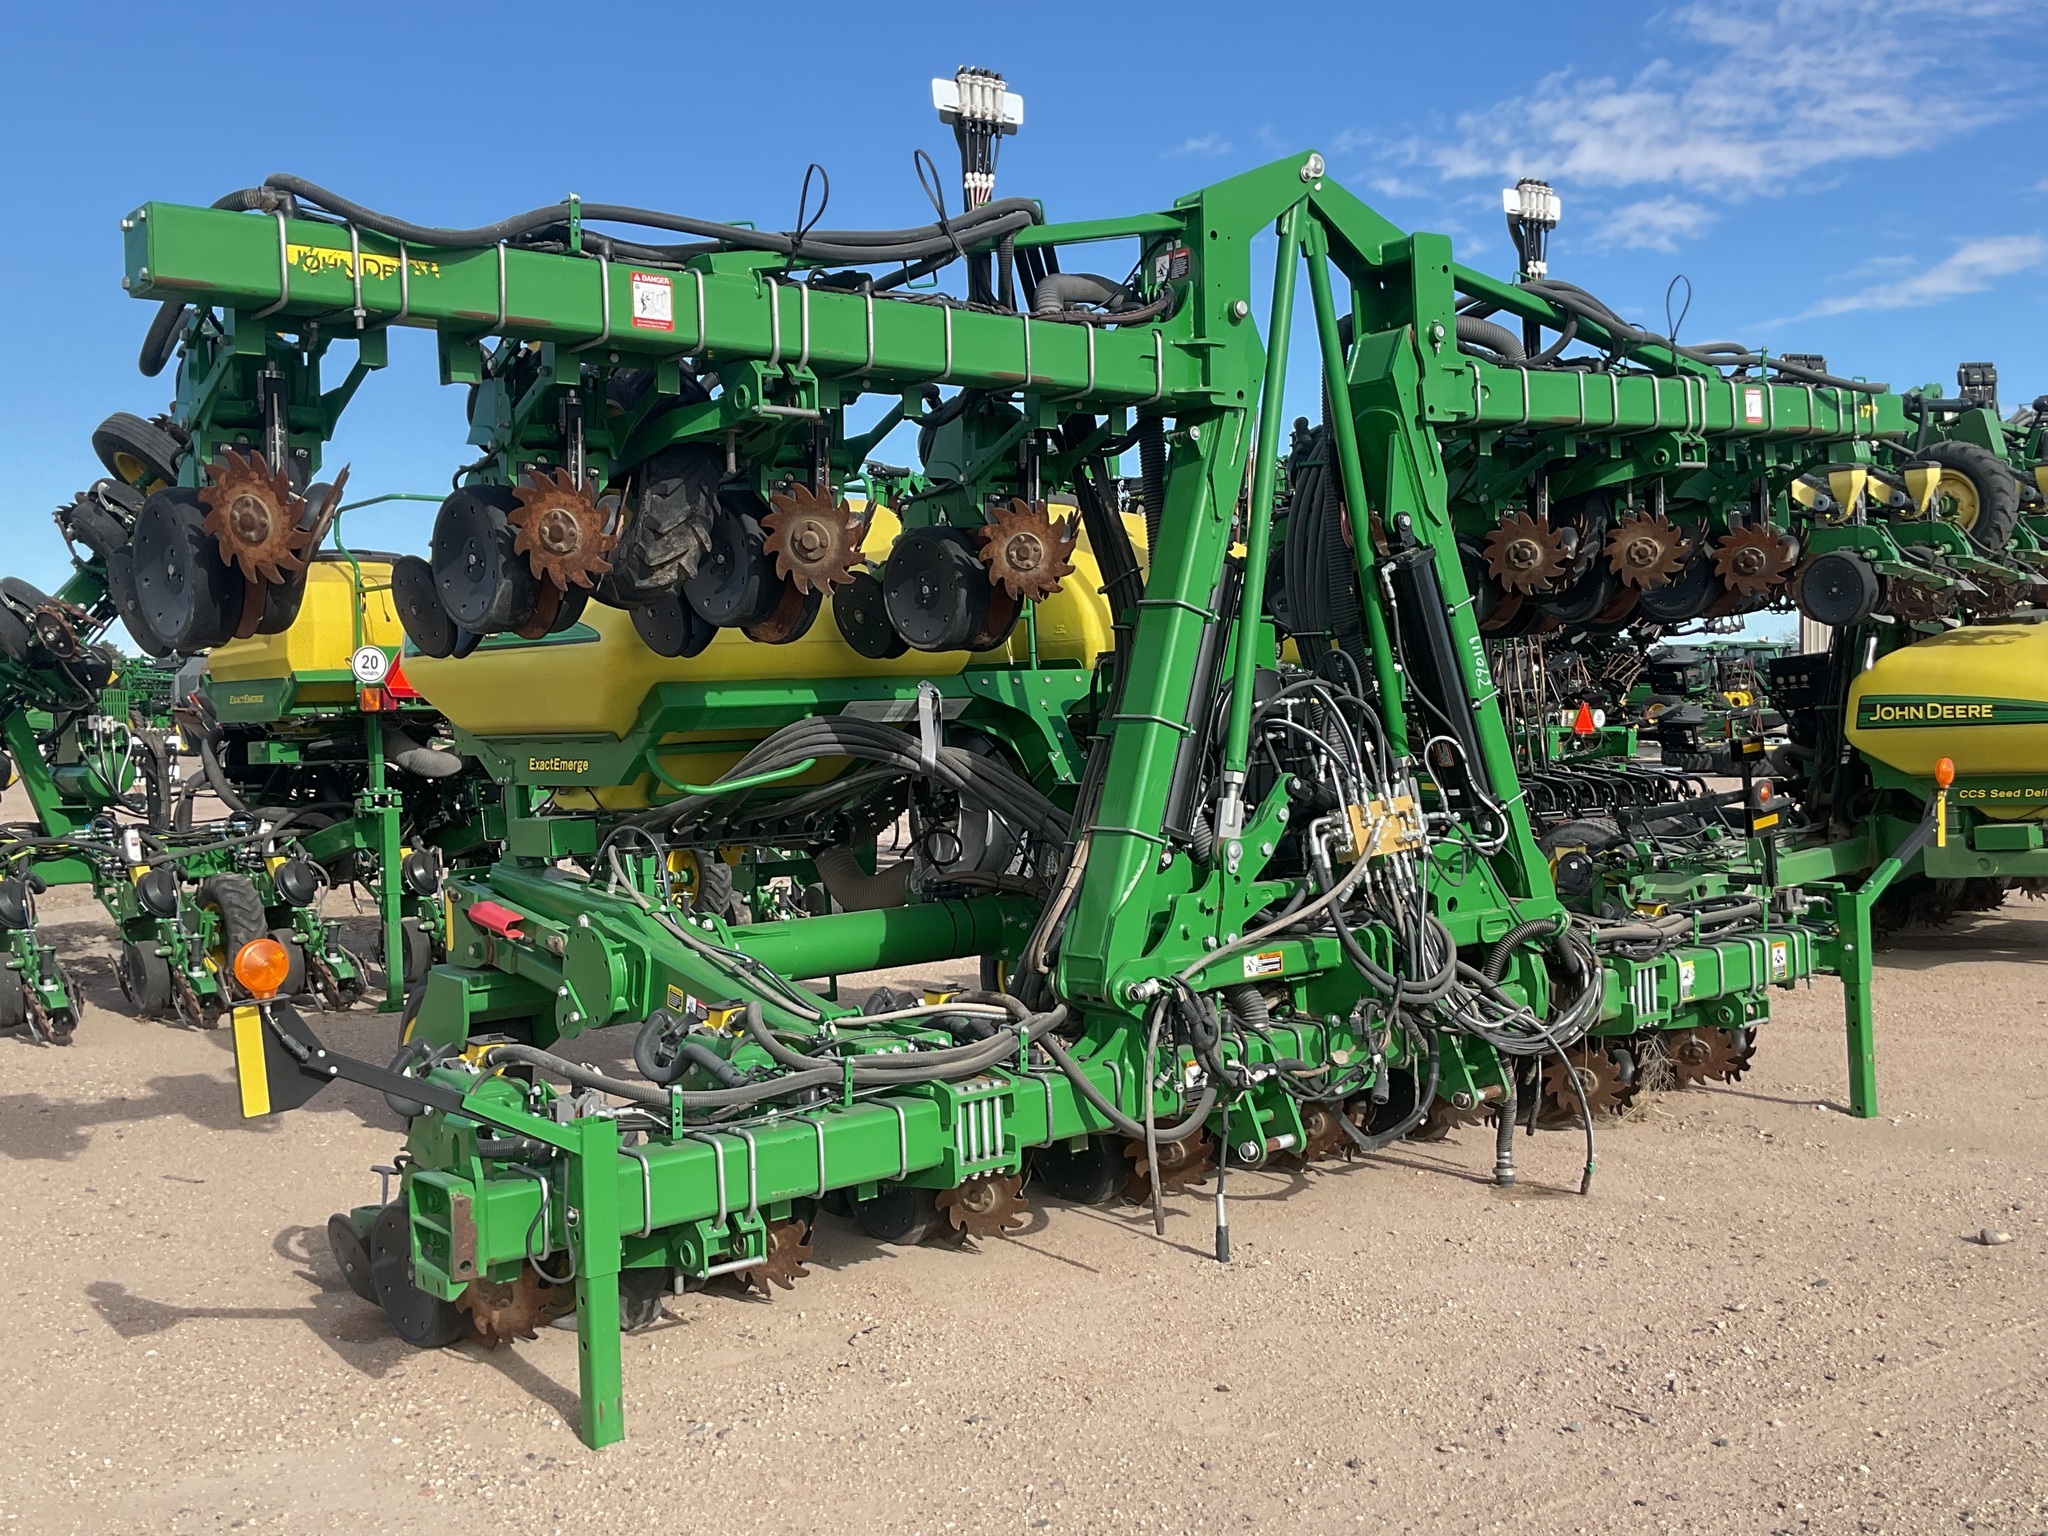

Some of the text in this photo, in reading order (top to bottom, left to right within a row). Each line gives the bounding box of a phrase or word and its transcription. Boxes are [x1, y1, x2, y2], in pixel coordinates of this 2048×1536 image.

[641, 274, 670, 285] DANGER
[361, 654, 379, 670] 20
[1469, 635, 1492, 690] 611062
[1869, 702, 1993, 721] JOHN DEERE
[528, 757, 590, 774] ExactEmerge
[1959, 788, 1987, 799] CCS
[1989, 788, 2021, 798] Seed
